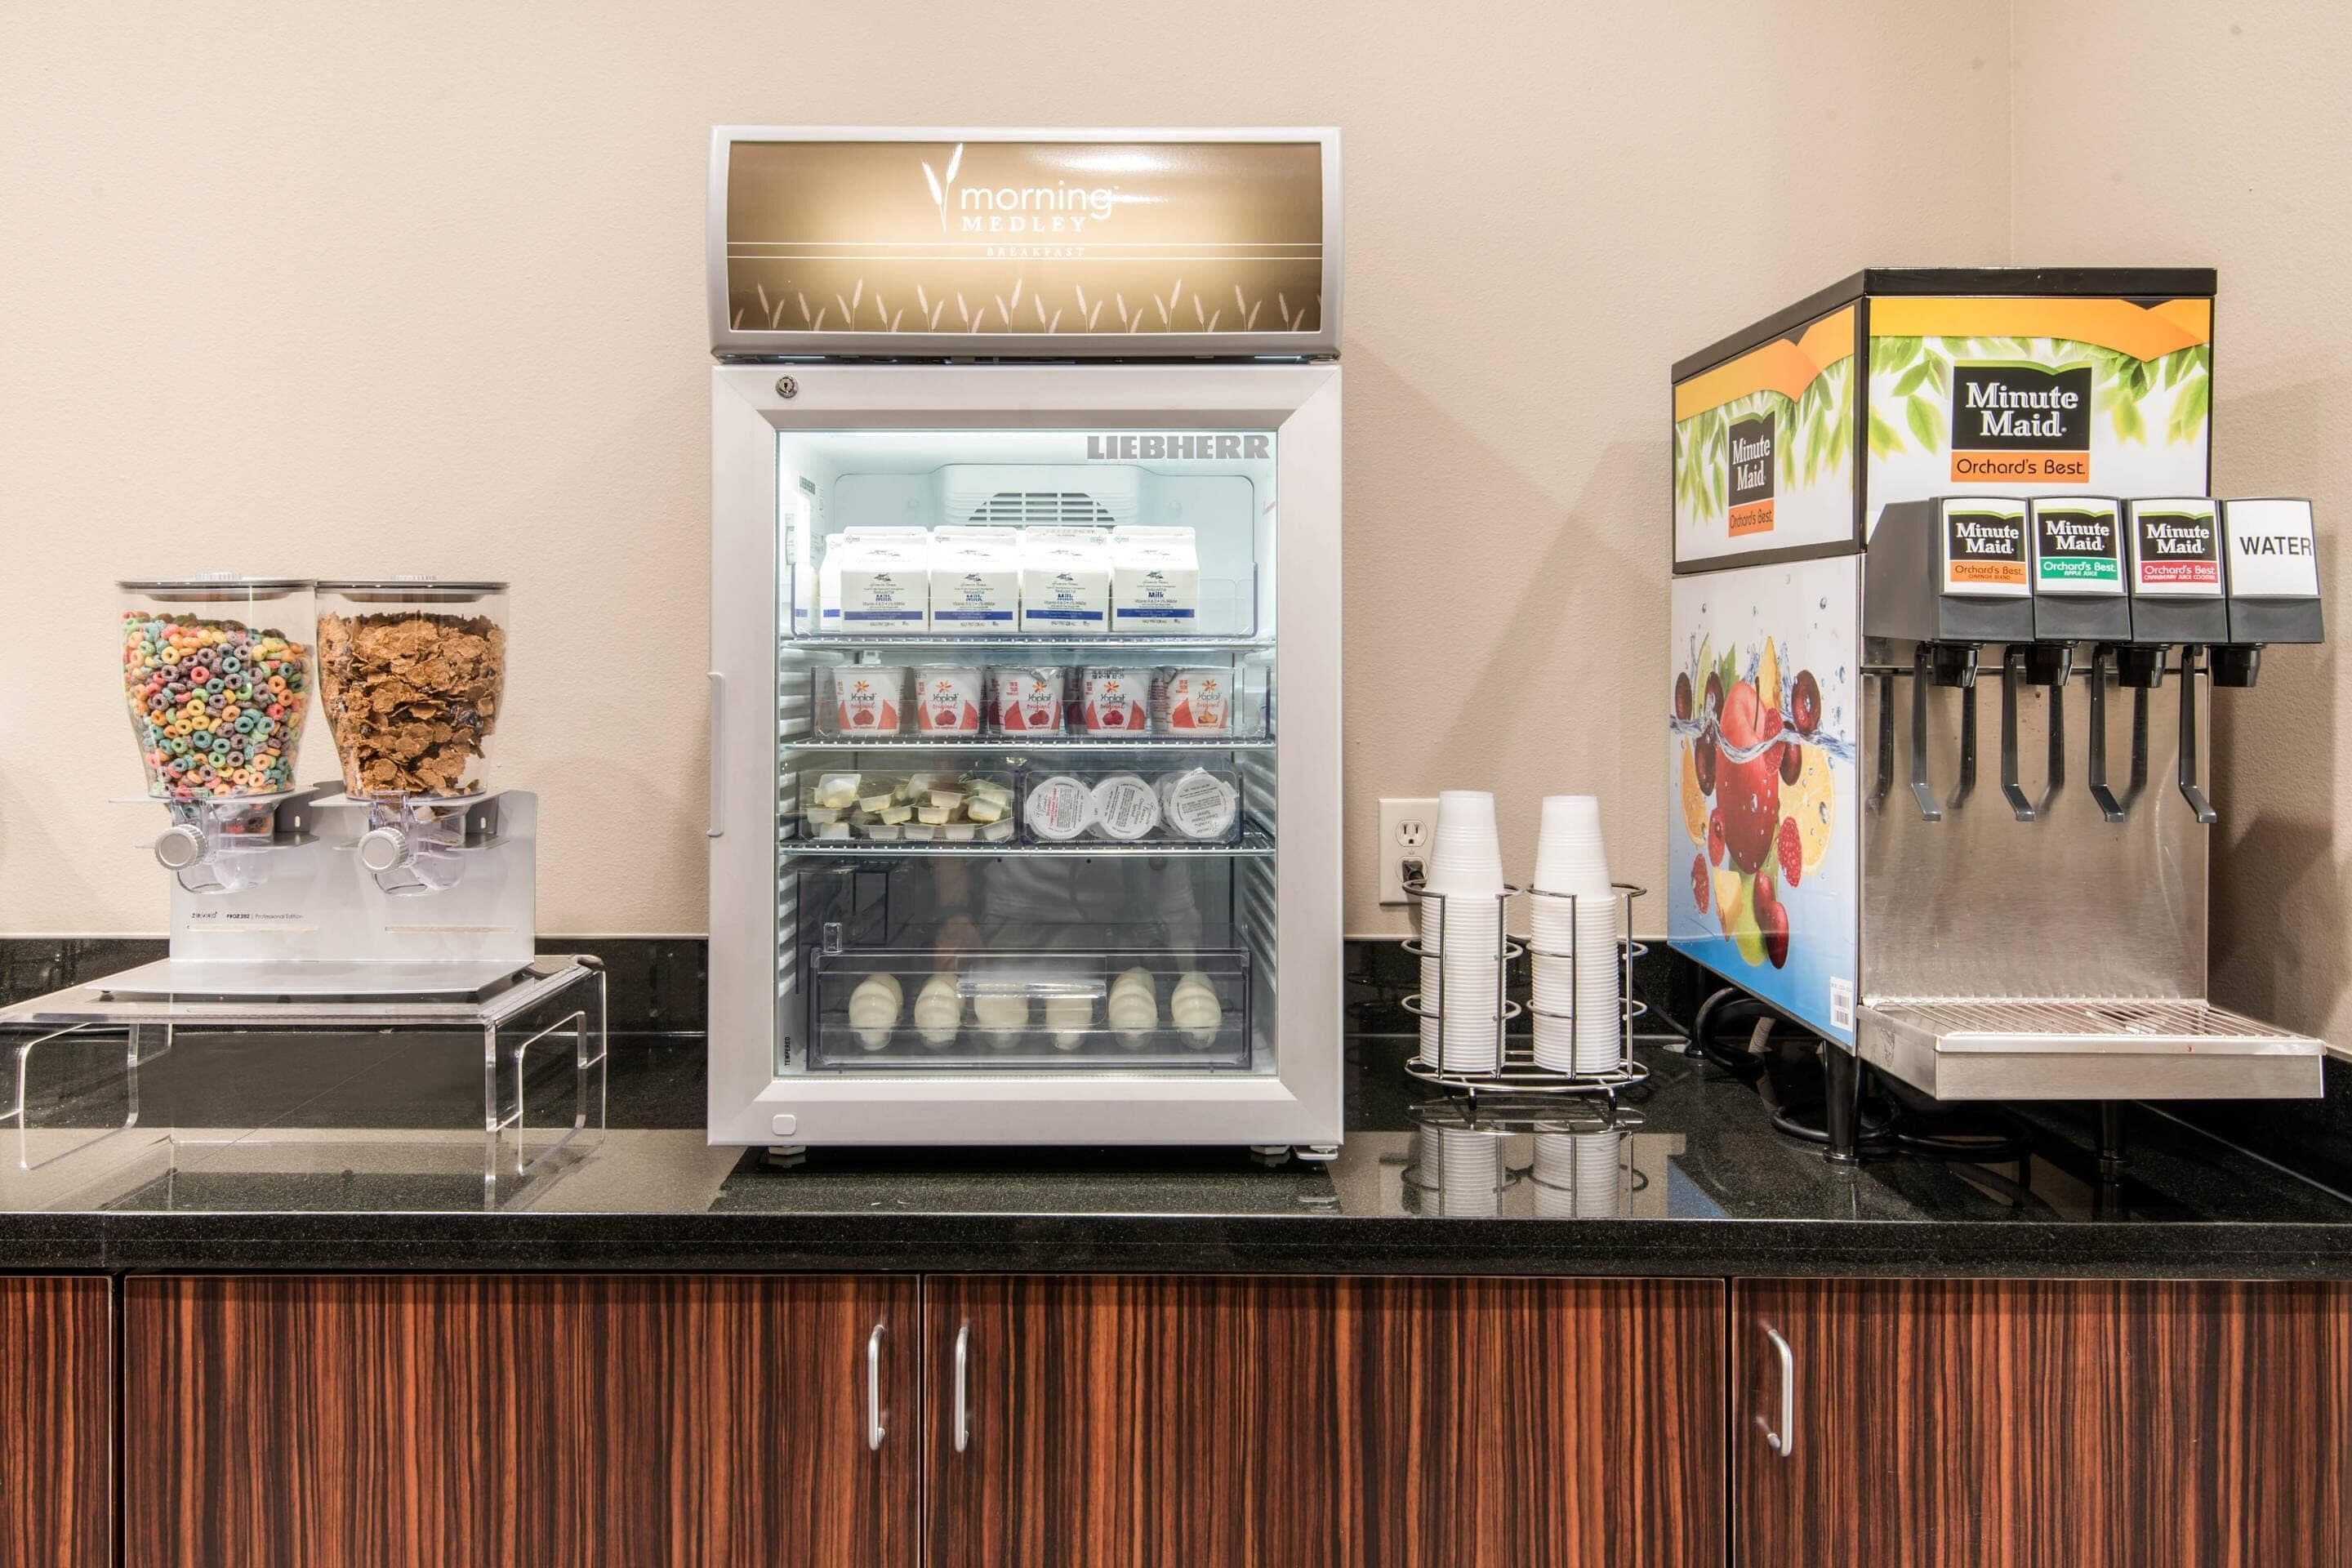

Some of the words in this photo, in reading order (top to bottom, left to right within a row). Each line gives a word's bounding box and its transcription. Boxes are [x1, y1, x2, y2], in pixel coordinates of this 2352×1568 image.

[960, 180, 1112, 220] morning
[960, 216, 1086, 233] MEDLEY
[987, 247, 1085, 256] BREAKFAST
[1965, 381, 2079, 409] Minute
[1979, 411, 2064, 438] Maid
[1087, 435, 1271, 459] LIEBHERR
[1732, 434, 1771, 466] Minute
[1956, 458, 2037, 474] Orchard's
[2044, 459, 2085, 474] Best
[1736, 461, 1765, 492] Maid
[1730, 512, 1757, 529] Orchard's
[1757, 510, 1773, 524] Best
[1955, 523, 2020, 539] Minute
[2045, 520, 2110, 537] Minute
[2145, 523, 2210, 539] Minute
[1965, 538, 2014, 555] Maid
[2055, 536, 2105, 551] Maid
[2156, 539, 2205, 555] Maid
[2239, 536, 2313, 556] WATER
[1954, 565, 2000, 574] Orchard's
[2002, 566, 2024, 576] Best
[2043, 561, 2091, 571] Orchard's
[2094, 562, 2117, 572] Best
[2144, 564, 2193, 574] Orchard's
[2194, 565, 2216, 575] Best
[875, 594, 893, 602] Milk
[965, 594, 983, 602] Milk
[851, 693, 875, 705] Yoplait
[933, 693, 957, 704] Yoplait
[1027, 693, 1052, 704] Yoplait
[1101, 693, 1125, 704] Yoplait
